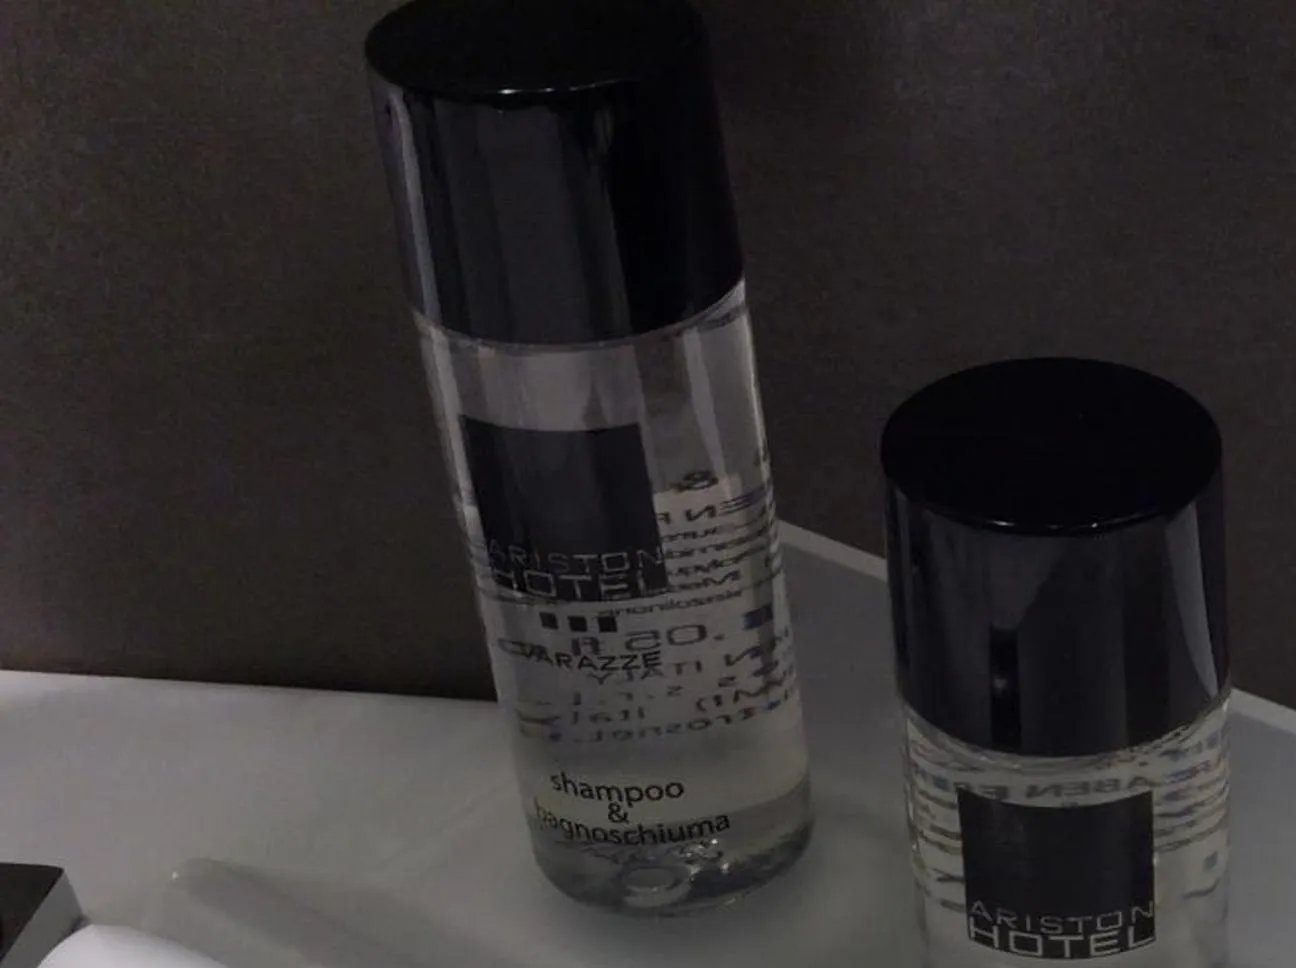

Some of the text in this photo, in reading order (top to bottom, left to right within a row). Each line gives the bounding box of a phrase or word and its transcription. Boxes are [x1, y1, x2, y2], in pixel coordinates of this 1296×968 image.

[488, 538, 664, 572] ARISTON
[492, 568, 669, 601] HOTEL
[550, 772, 685, 804] shampoo
[533, 798, 731, 848] bagnoschiuma
[606, 803, 629, 825] &
[970, 900, 1153, 936] ARISTON
[968, 918, 1156, 958] HOTEL
